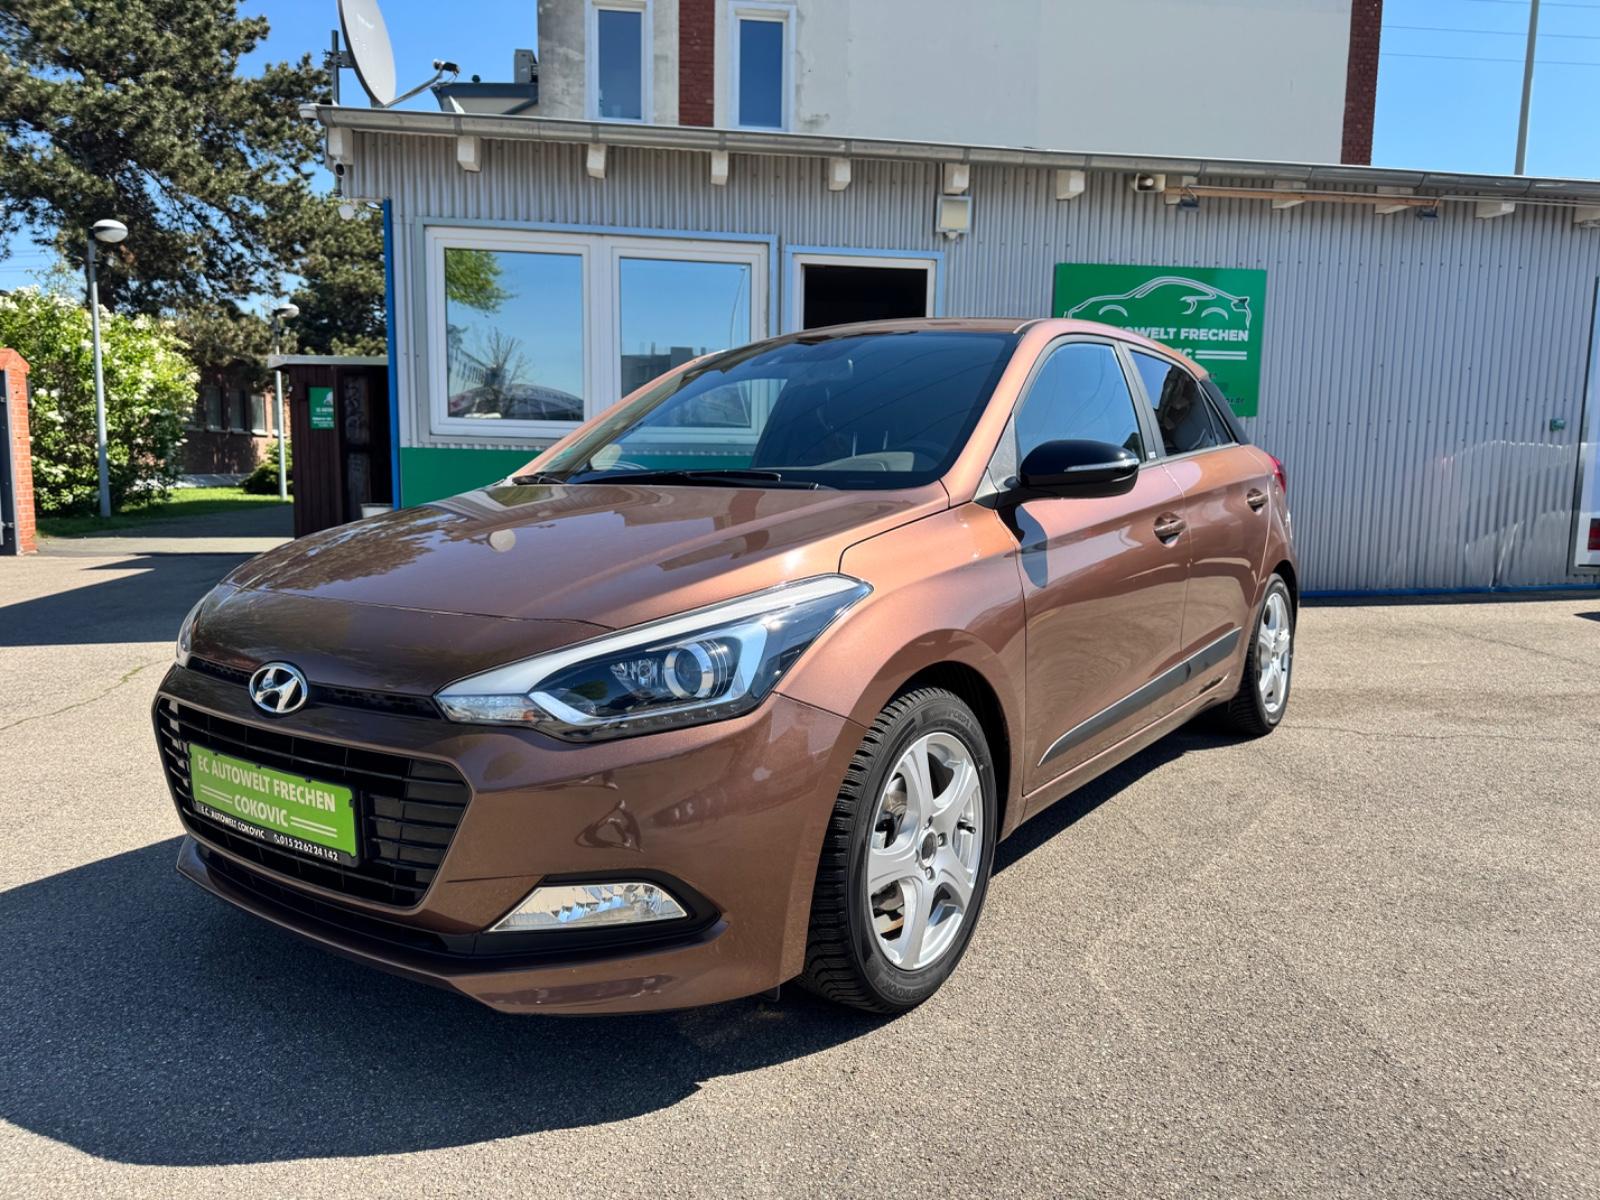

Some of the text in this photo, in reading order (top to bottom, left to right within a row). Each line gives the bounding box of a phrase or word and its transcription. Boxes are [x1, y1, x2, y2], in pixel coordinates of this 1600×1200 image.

[1180, 328, 1249, 341] FRECHEN
[197, 755, 336, 812] EC AUTOWELT FRECHEN
[234, 794, 288, 827] COKOVIC
[238, 821, 265, 839] COKOVIC
